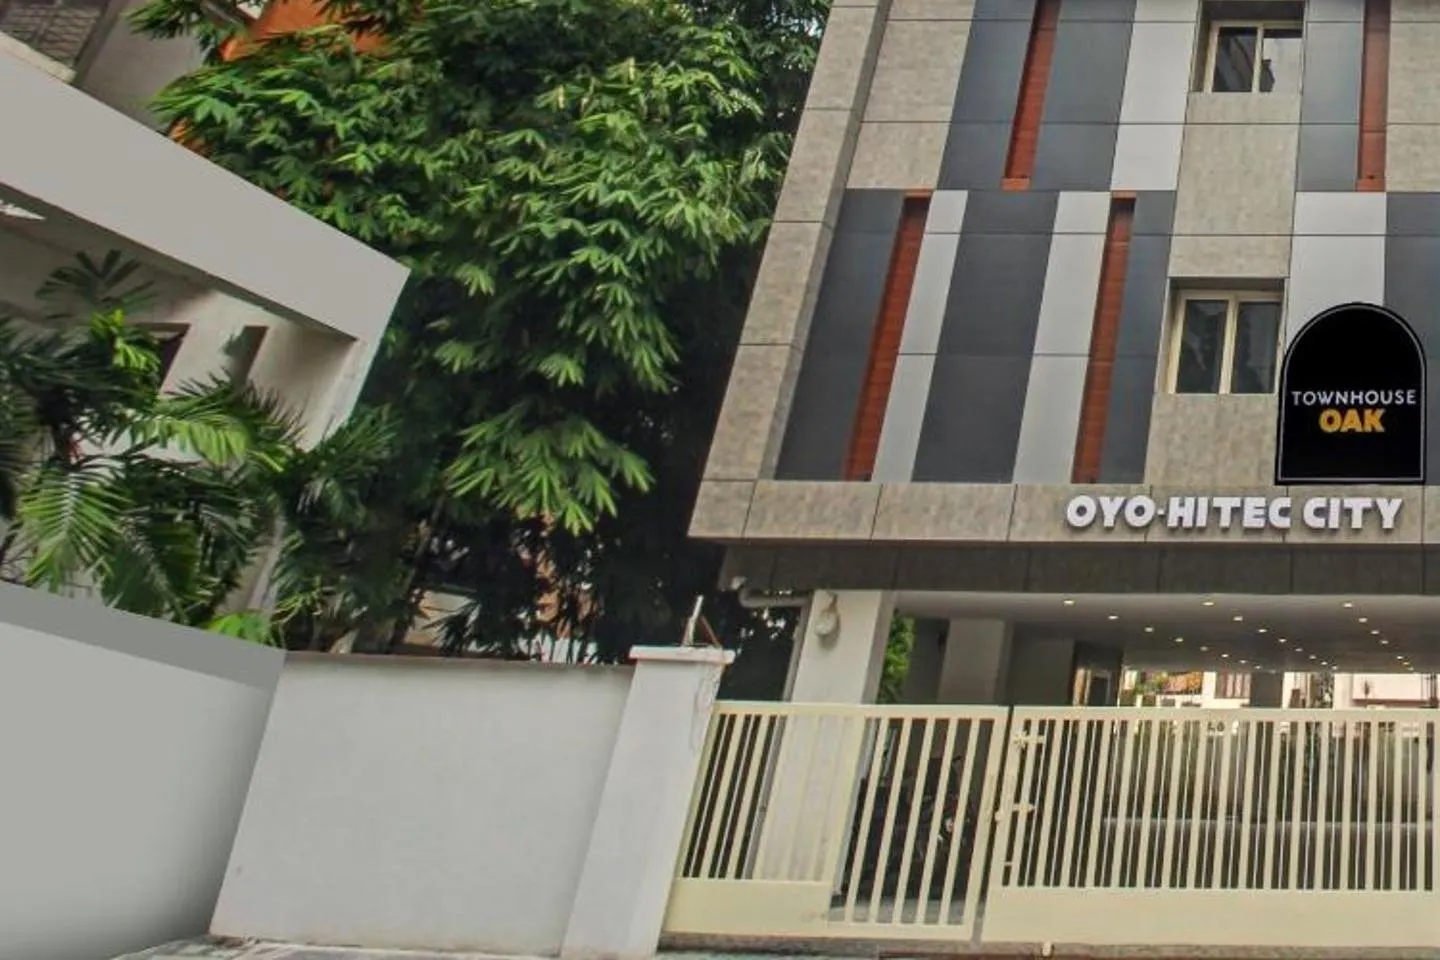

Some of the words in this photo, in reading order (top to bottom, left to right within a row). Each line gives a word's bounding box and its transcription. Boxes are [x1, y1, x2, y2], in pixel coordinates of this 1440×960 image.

[1292, 389, 1417, 406] TOWNHOUSE
[1318, 408, 1386, 433] OAK
[1303, 497, 1402, 529] CITY
